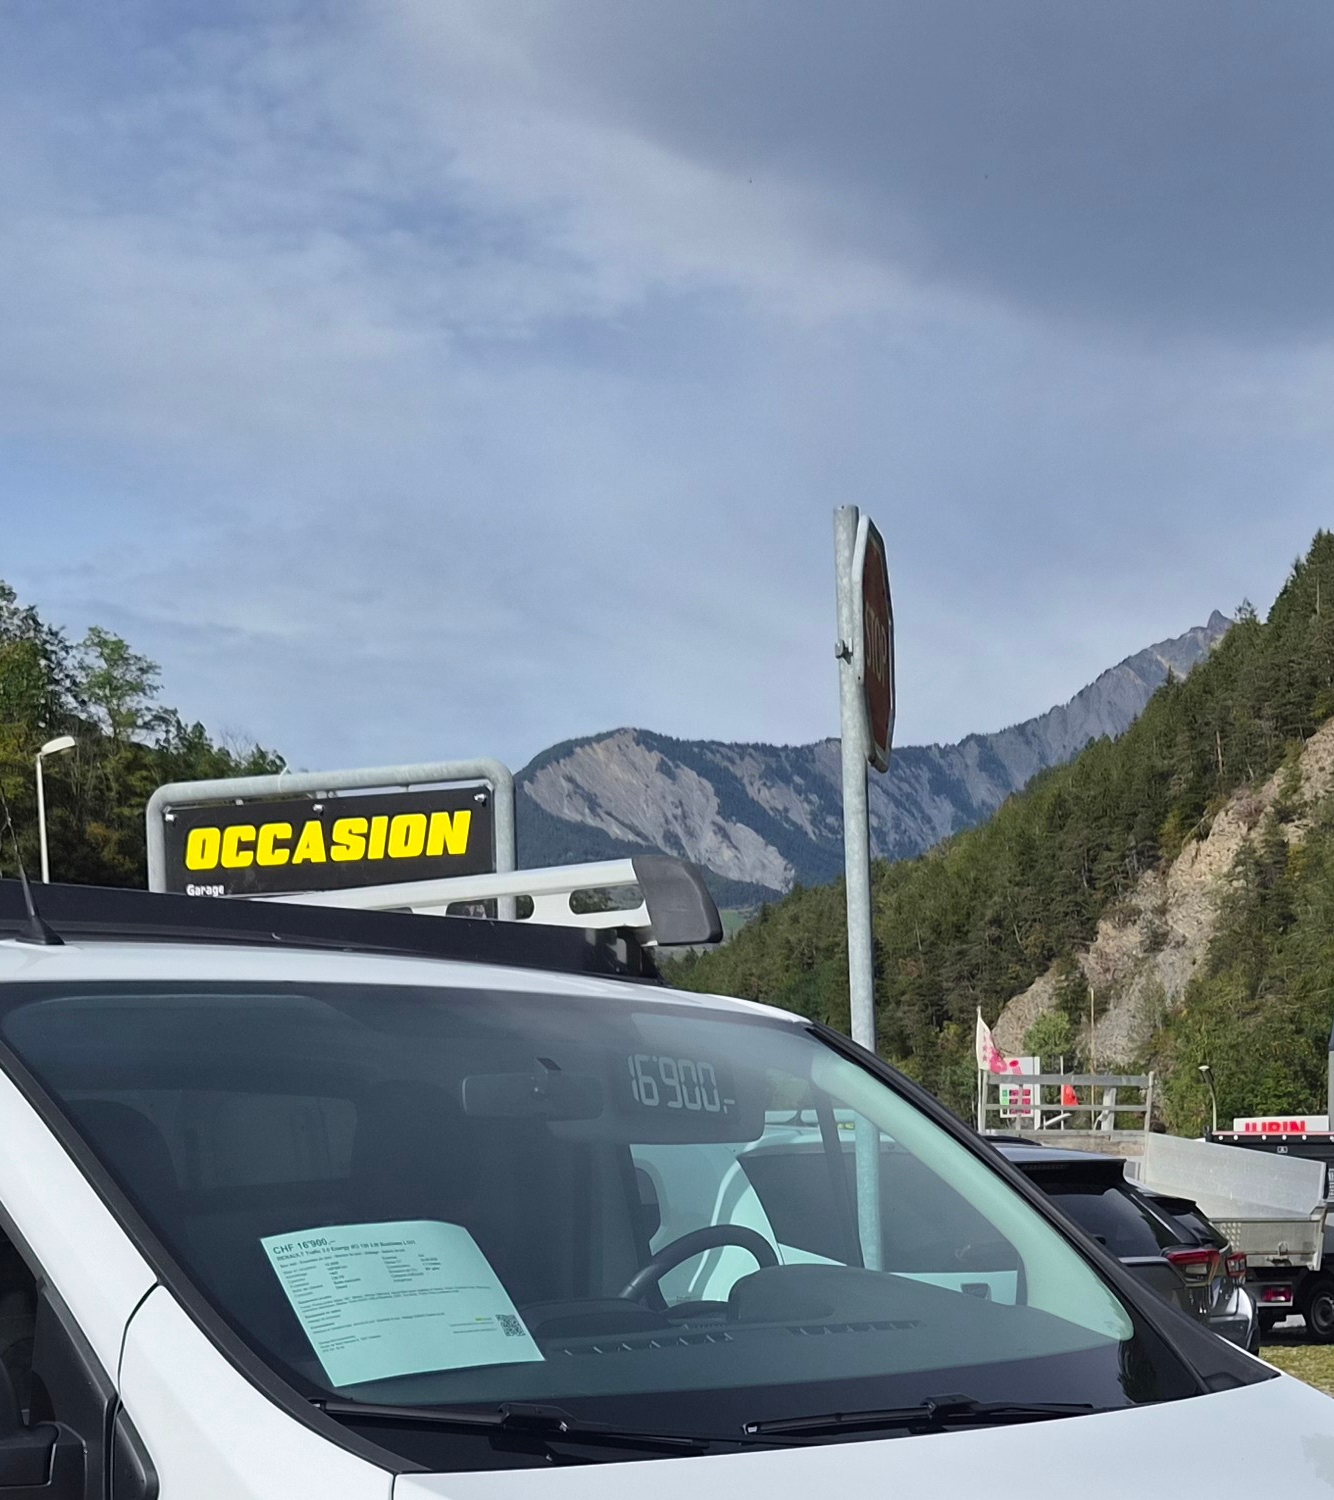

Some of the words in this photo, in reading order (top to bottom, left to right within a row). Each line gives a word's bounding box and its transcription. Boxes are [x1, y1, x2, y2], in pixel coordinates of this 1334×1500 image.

[865, 601, 887, 688] STOP
[185, 810, 472, 870] OCCASION
[186, 884, 224, 898] Garage
[273, 1243, 295, 1255] CHF
